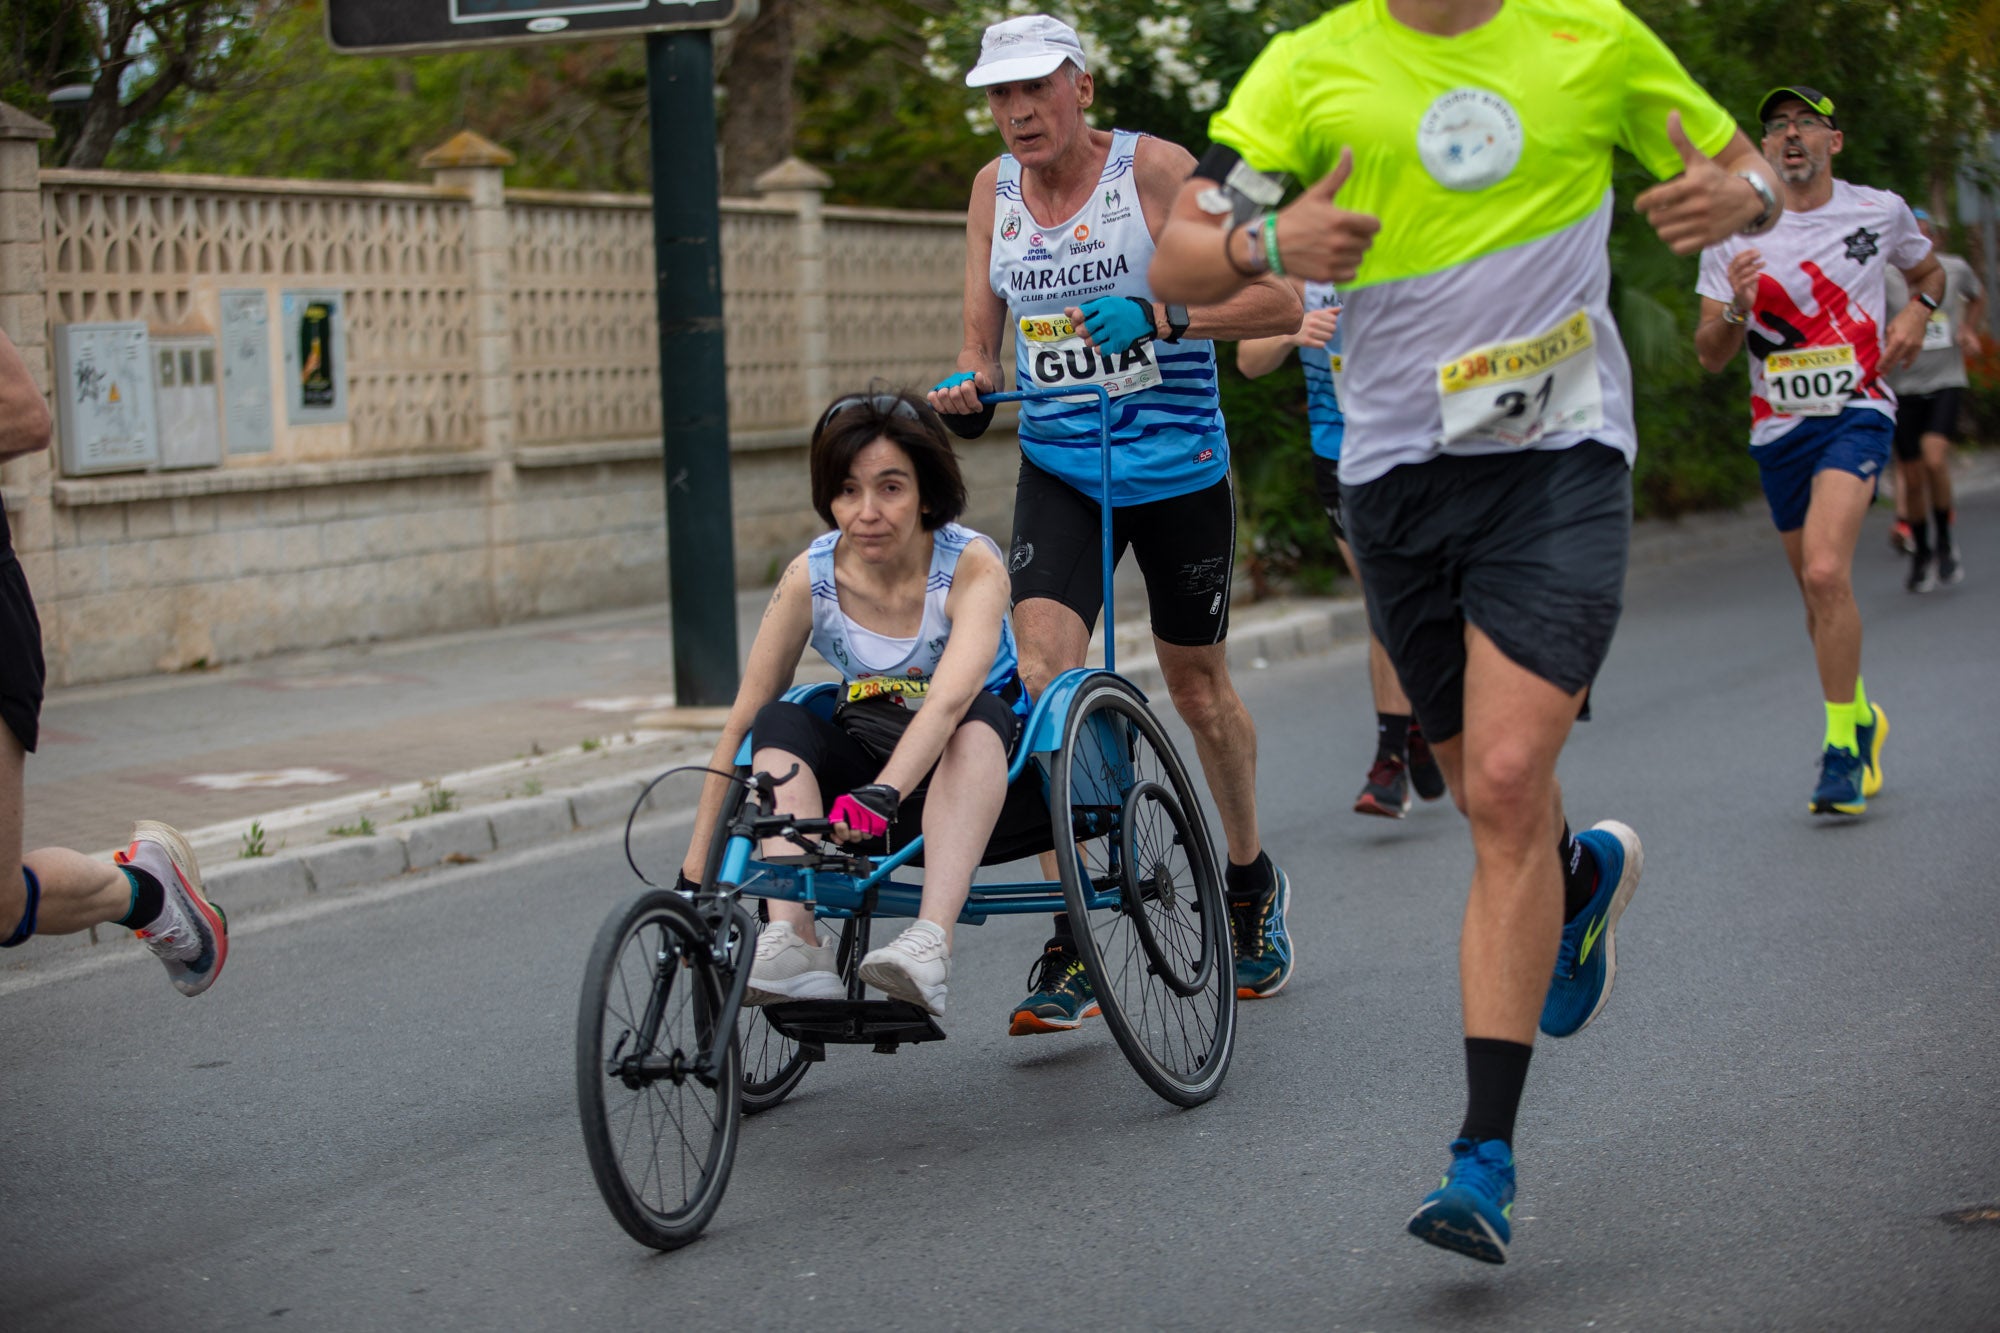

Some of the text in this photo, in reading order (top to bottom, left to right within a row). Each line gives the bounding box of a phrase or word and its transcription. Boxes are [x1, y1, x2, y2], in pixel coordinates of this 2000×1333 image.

[1070, 239, 1106, 255] mayfo
[1010, 254, 1130, 291] MARACENA
[1021, 294, 1044, 302] CLUB
[1061, 283, 1116, 298] ATLETISMO
[1034, 321, 1053, 336] 38
[1461, 355, 1489, 380] 38
[1770, 370, 1854, 400] 1002
